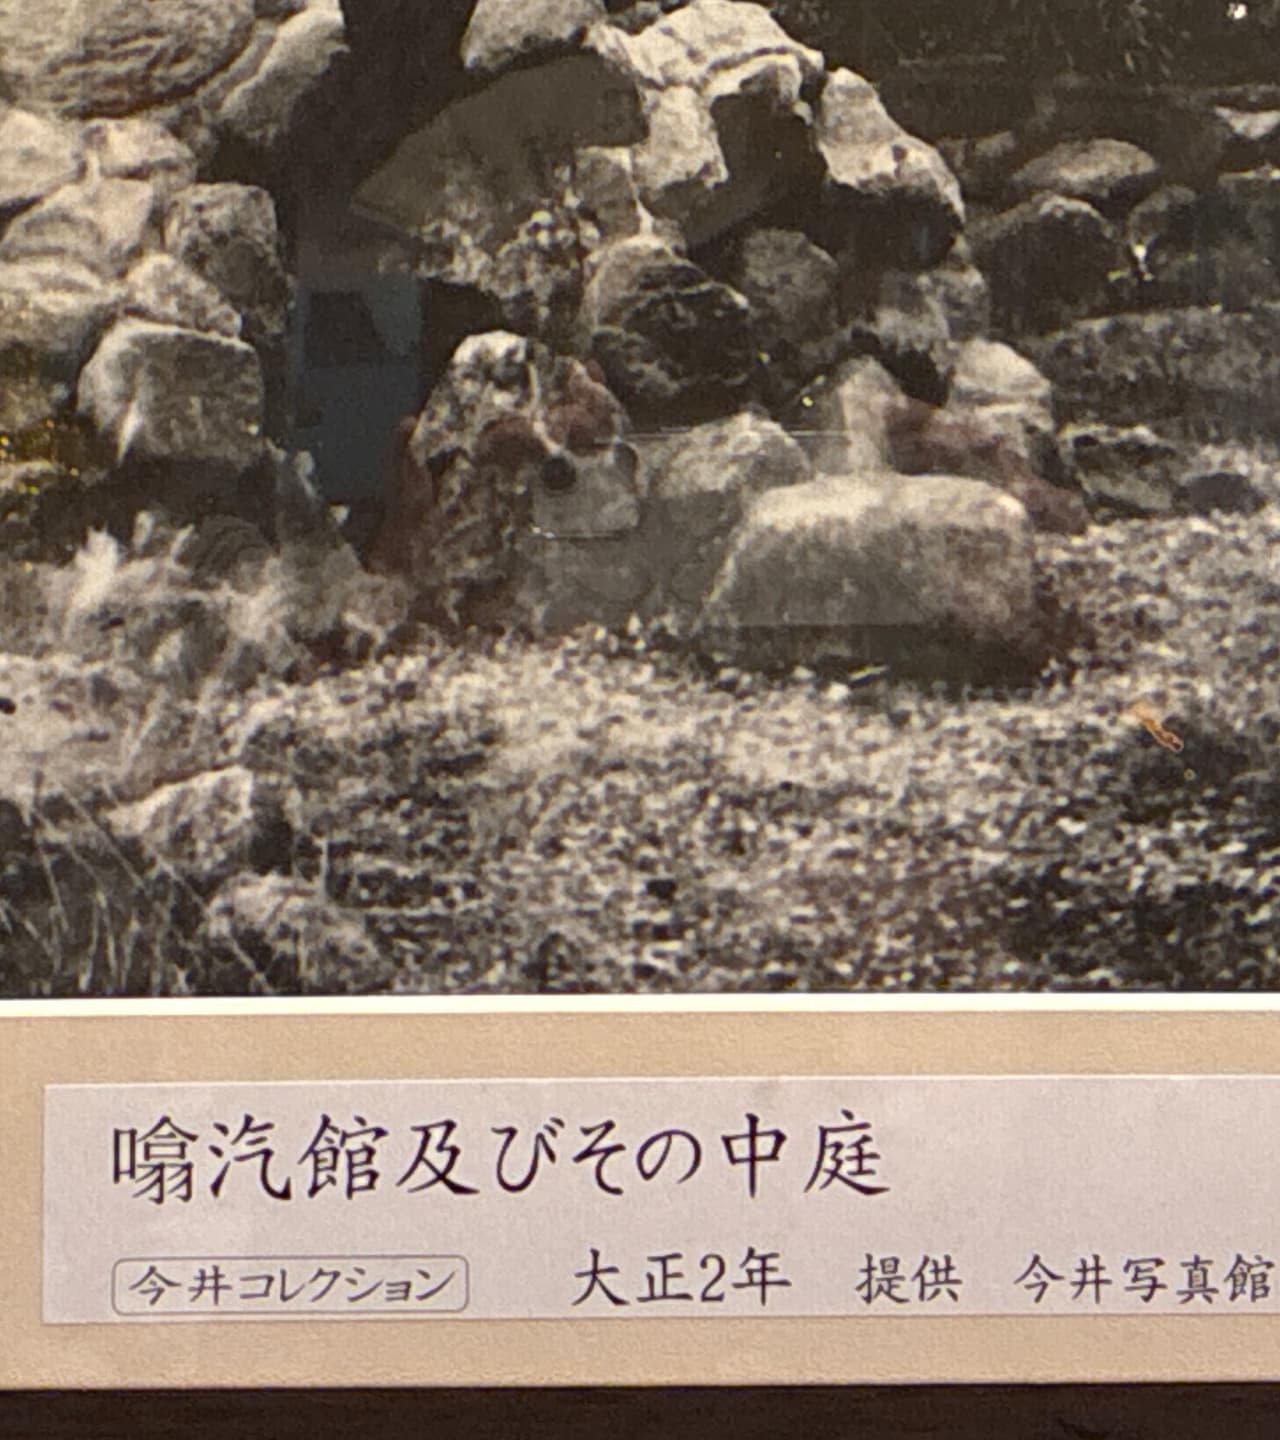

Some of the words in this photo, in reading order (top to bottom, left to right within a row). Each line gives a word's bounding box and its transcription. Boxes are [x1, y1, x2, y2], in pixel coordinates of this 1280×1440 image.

[112, 1110, 891, 1206] 噏汽館及びその中庭
[128, 1264, 456, 1306] 今井コレクション
[574, 1248, 793, 1307] 大正2年
[854, 1252, 964, 1304] 提供
[1012, 1253, 1276, 1305] 今井写真館
